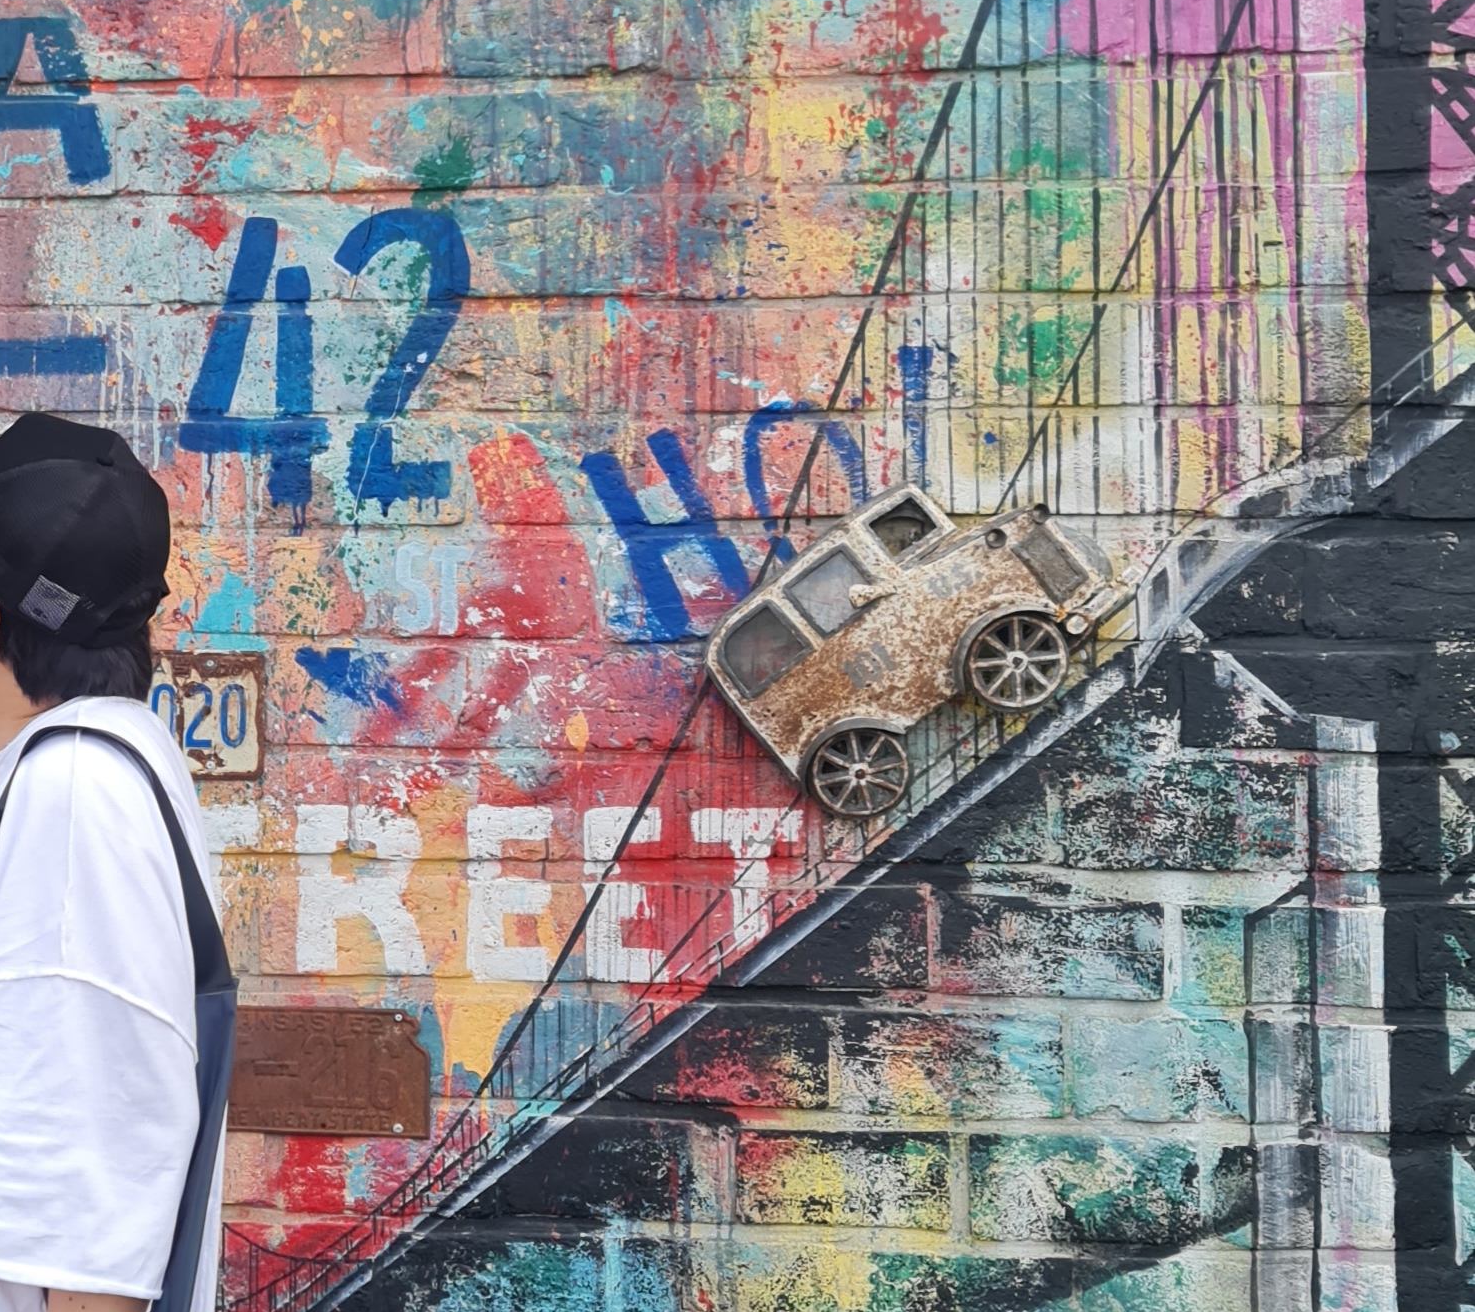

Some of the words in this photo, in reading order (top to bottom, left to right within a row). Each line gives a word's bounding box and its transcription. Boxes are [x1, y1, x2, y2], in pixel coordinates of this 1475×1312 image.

[179, 206, 472, 519] 42
[394, 541, 472, 636] ST
[201, 804, 804, 983] REET
[238, 1012, 326, 1033] ANSAS
